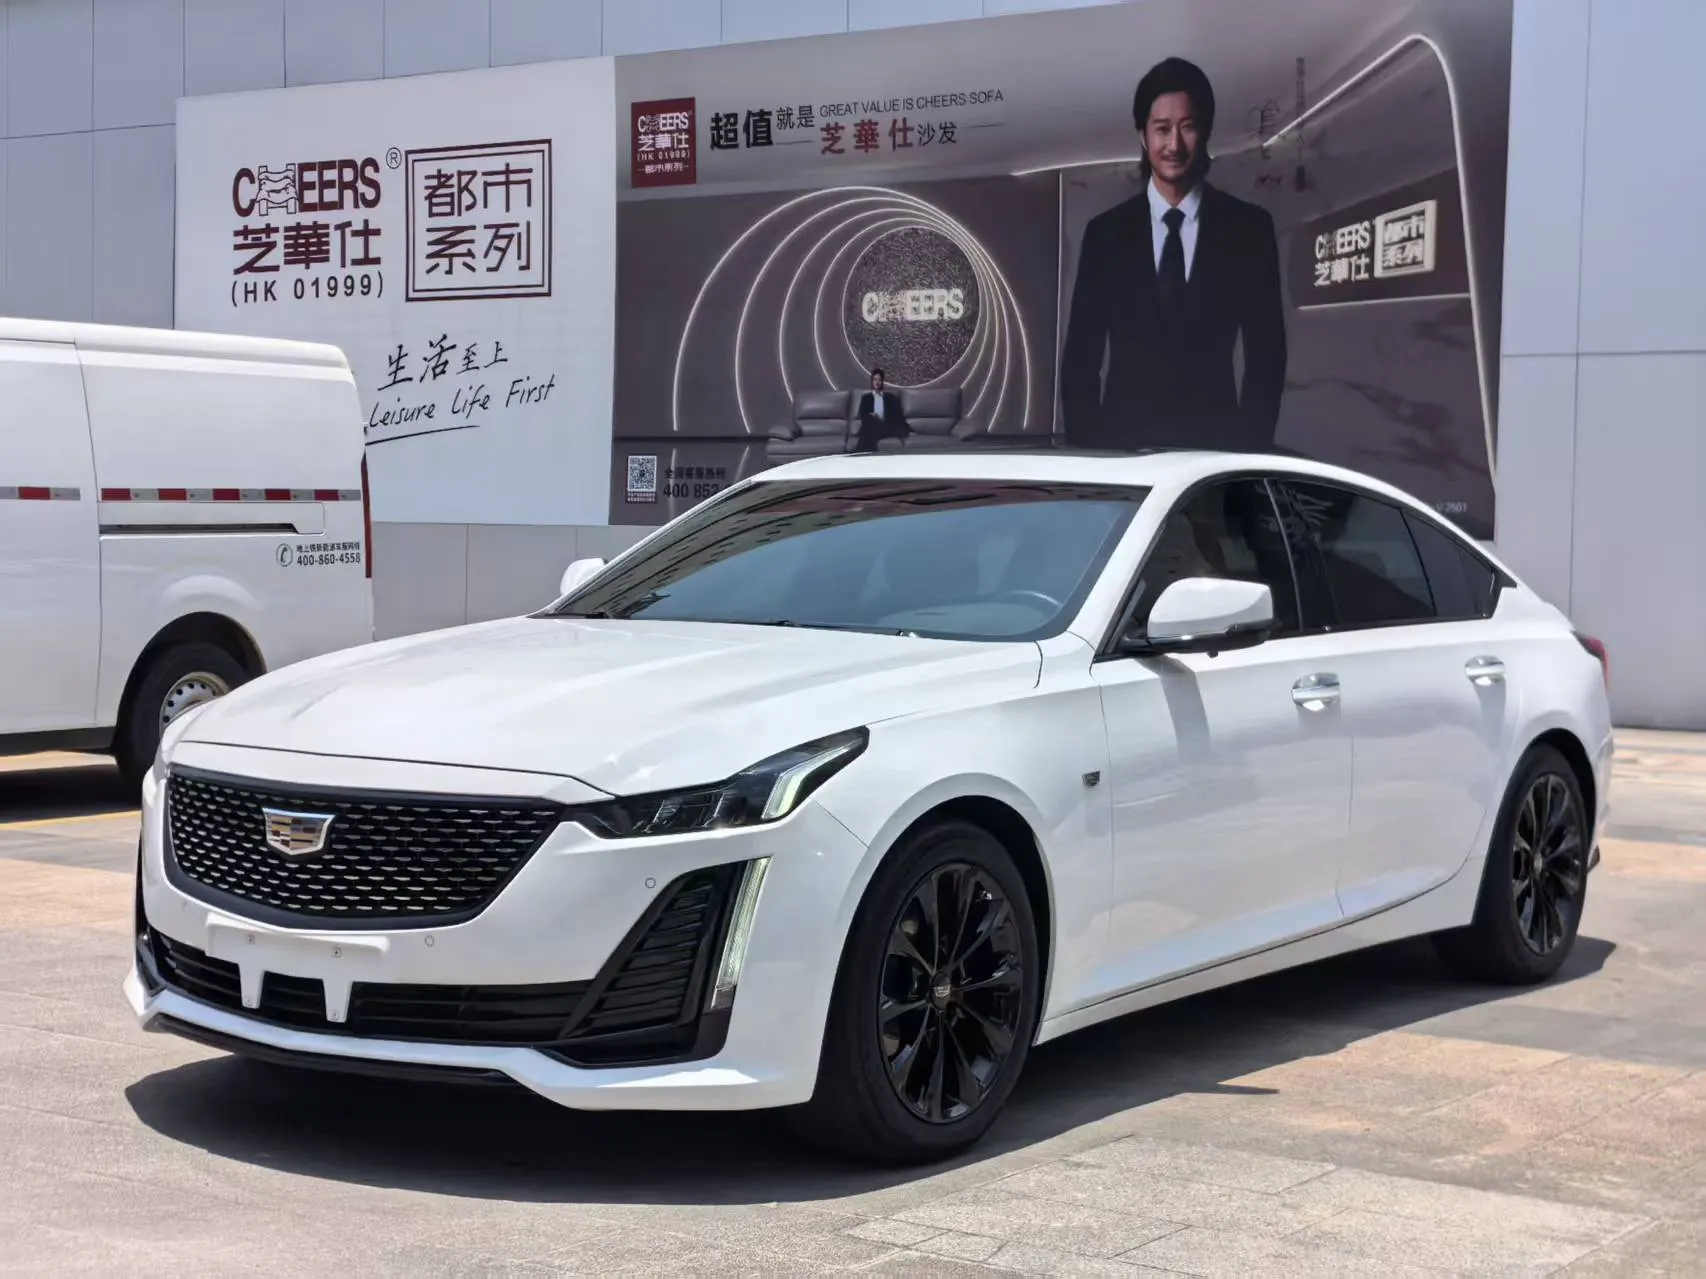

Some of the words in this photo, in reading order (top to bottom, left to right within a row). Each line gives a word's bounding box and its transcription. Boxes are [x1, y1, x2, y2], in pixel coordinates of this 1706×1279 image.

[775, 104, 816, 130] 就是
[819, 102, 859, 118] GREAT
[861, 99, 900, 114] VALUE
[902, 98, 914, 111] IS
[916, 92, 966, 110] CHEERS
[968, 88, 1004, 105] SOFA
[637, 132, 690, 152] 芝華仕
[709, 109, 774, 151] 超值
[232, 156, 382, 218] CHEERS
[424, 162, 534, 218] 都市
[232, 219, 382, 276] 芝華仕
[425, 220, 532, 275] 系列
[231, 279, 278, 308] (HK
[293, 270, 384, 300] 01999)
[377, 333, 509, 392] 生活至上
[368, 396, 437, 429] Leisure
[451, 384, 491, 420] Life
[505, 373, 556, 408] First
[663, 482, 690, 499] 400
